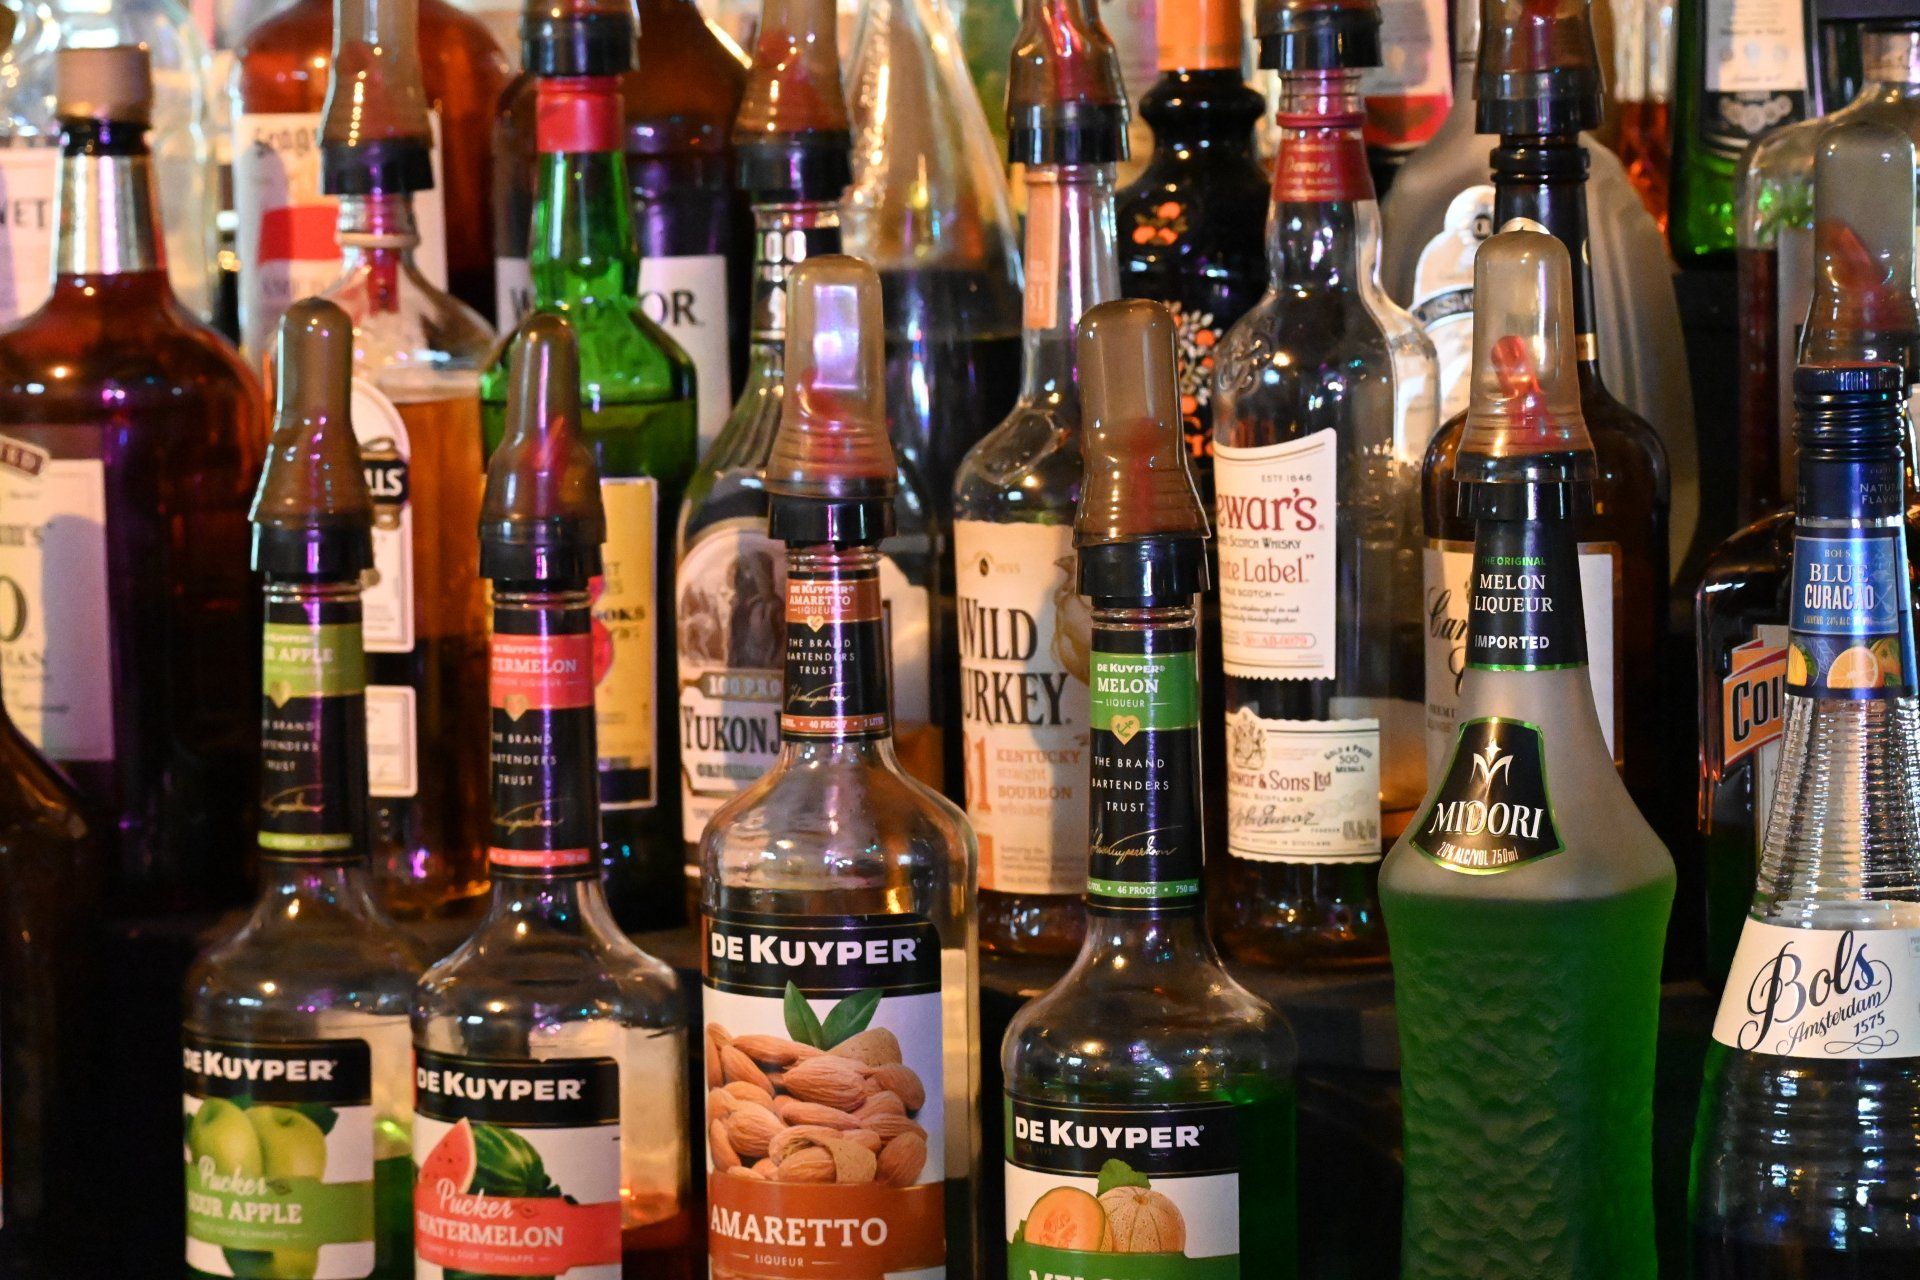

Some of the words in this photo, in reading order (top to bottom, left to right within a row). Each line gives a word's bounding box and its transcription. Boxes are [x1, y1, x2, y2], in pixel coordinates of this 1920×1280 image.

[1496, 556, 1546, 567] ORIGINAL
[1479, 573, 1547, 590] MELON
[1809, 563, 1869, 583] BLUE
[801, 584, 849, 594] KUYPER
[789, 595, 851, 606] AMARETTO
[1474, 595, 1555, 614] LIQUEUR
[959, 596, 1039, 661] WILD
[788, 637, 804, 648] THE
[809, 639, 851, 649] BRAND
[1474, 634, 1550, 650] IMPORTED
[787, 652, 856, 662] BARTENDERS
[799, 665, 834, 675] TRUST
[1096, 662, 1108, 673] DE
[1109, 662, 1160, 674] KUYPER
[1097, 677, 1160, 694] MELON
[1105, 698, 1146, 708] LIQUEUR
[680, 704, 767, 754] YUKON
[507, 733, 554, 745] BRAND
[1094, 755, 1111, 768] THE
[1117, 758, 1166, 769] BRAND
[498, 774, 534, 786] TRUST
[1091, 777, 1170, 791] BARTENDERS
[1268, 769, 1311, 792] Sons
[1313, 770, 1332, 792] Ltd
[1106, 801, 1145, 813] TRUST
[1428, 799, 1545, 840] MIDORI
[1436, 841, 1456, 860] 20%
[1453, 848, 1489, 867] ALC/VOL
[1492, 846, 1519, 865] 750ml
[1116, 885, 1127, 895] 46
[1128, 886, 1158, 896] PROOF
[1175, 885, 1188, 894] 750
[711, 932, 745, 962] DE
[749, 933, 918, 967] KUYPER
[1737, 929, 1892, 1051] Bols
[1776, 990, 1883, 1056] Amsterdam
[1854, 1010, 1886, 1037] 1575
[203, 1049, 334, 1082] KUYPER
[417, 1066, 440, 1094] DE
[443, 1070, 582, 1102] KUYPER
[1015, 1115, 1045, 1143] DE
[1050, 1118, 1201, 1150] KUYPER
[198, 1154, 268, 1197] Pucker
[435, 1177, 514, 1220] Pucker
[227, 1200, 303, 1225] APPLE
[711, 1203, 889, 1248] AMARETTO
[754, 1255, 805, 1267] LIQUEUR
